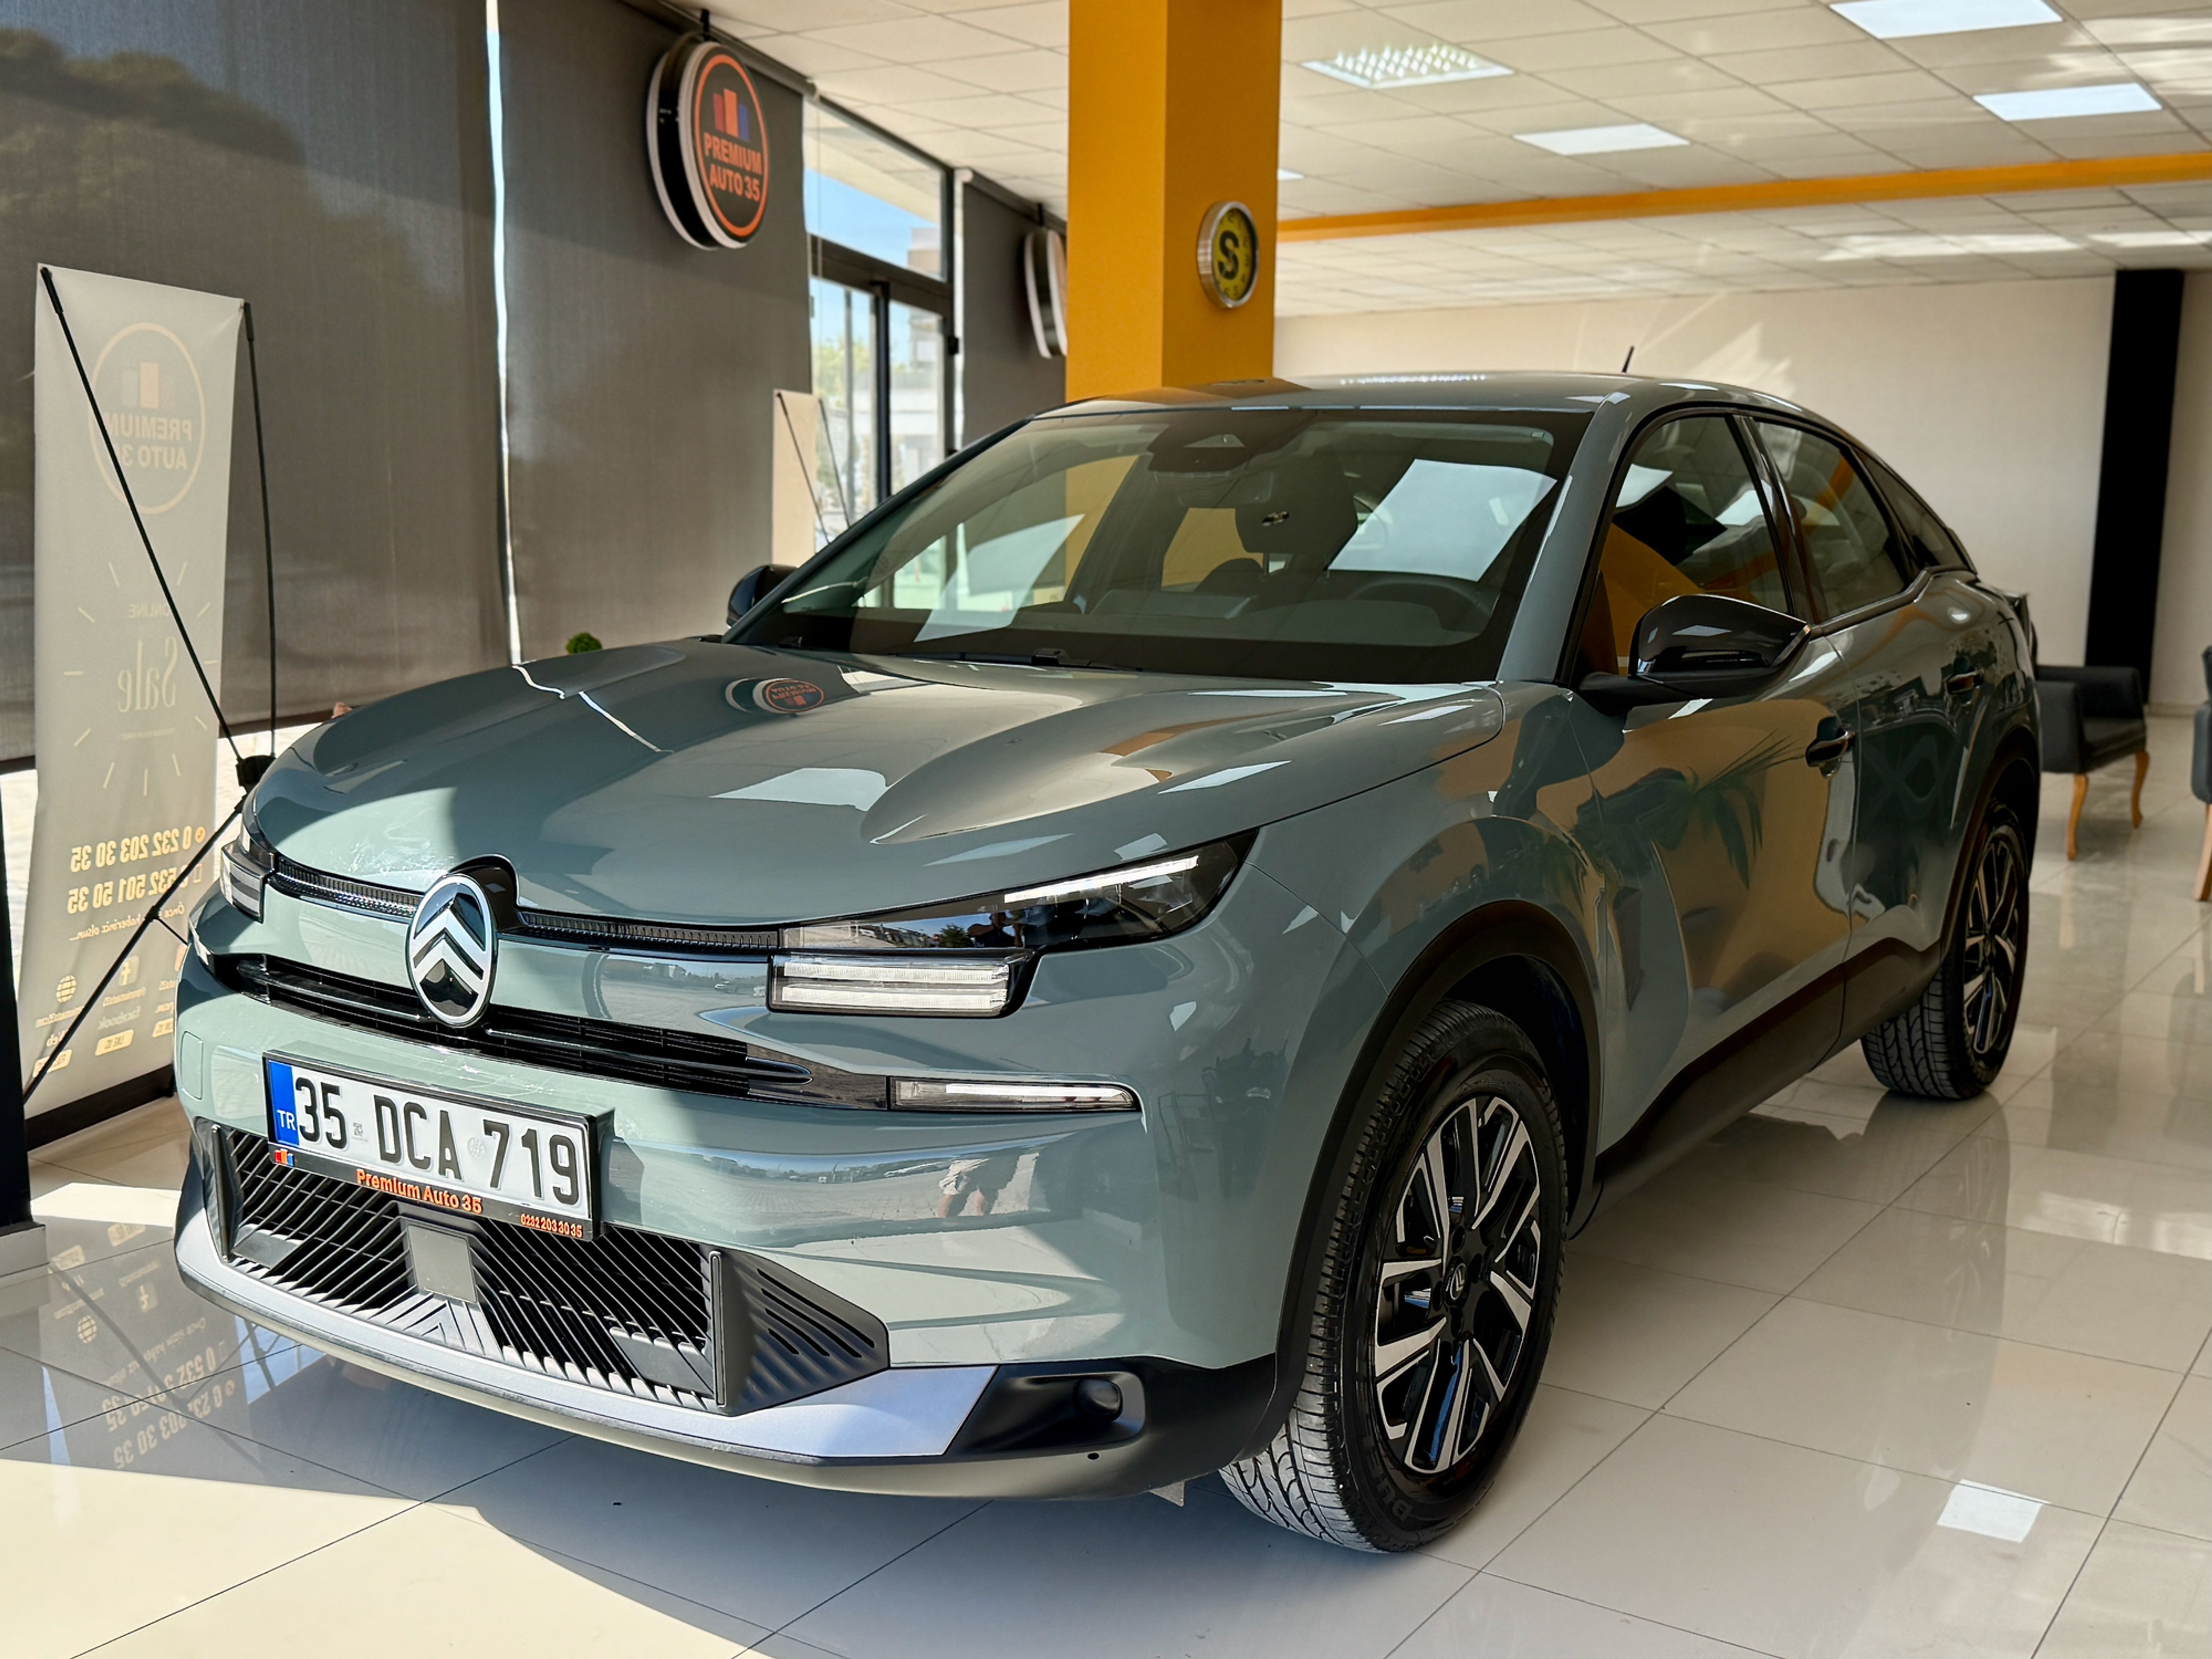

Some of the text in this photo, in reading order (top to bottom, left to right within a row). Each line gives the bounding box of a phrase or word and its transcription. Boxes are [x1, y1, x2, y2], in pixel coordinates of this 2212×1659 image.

[704, 132, 762, 175] PREMIUM
[710, 164, 760, 202] AUTO 35
[1218, 230, 1239, 280] S
[277, 1110, 295, 1130] TR
[295, 1077, 578, 1205] 35 DCA 719
[356, 1169, 483, 1215] Premium Auto 35
